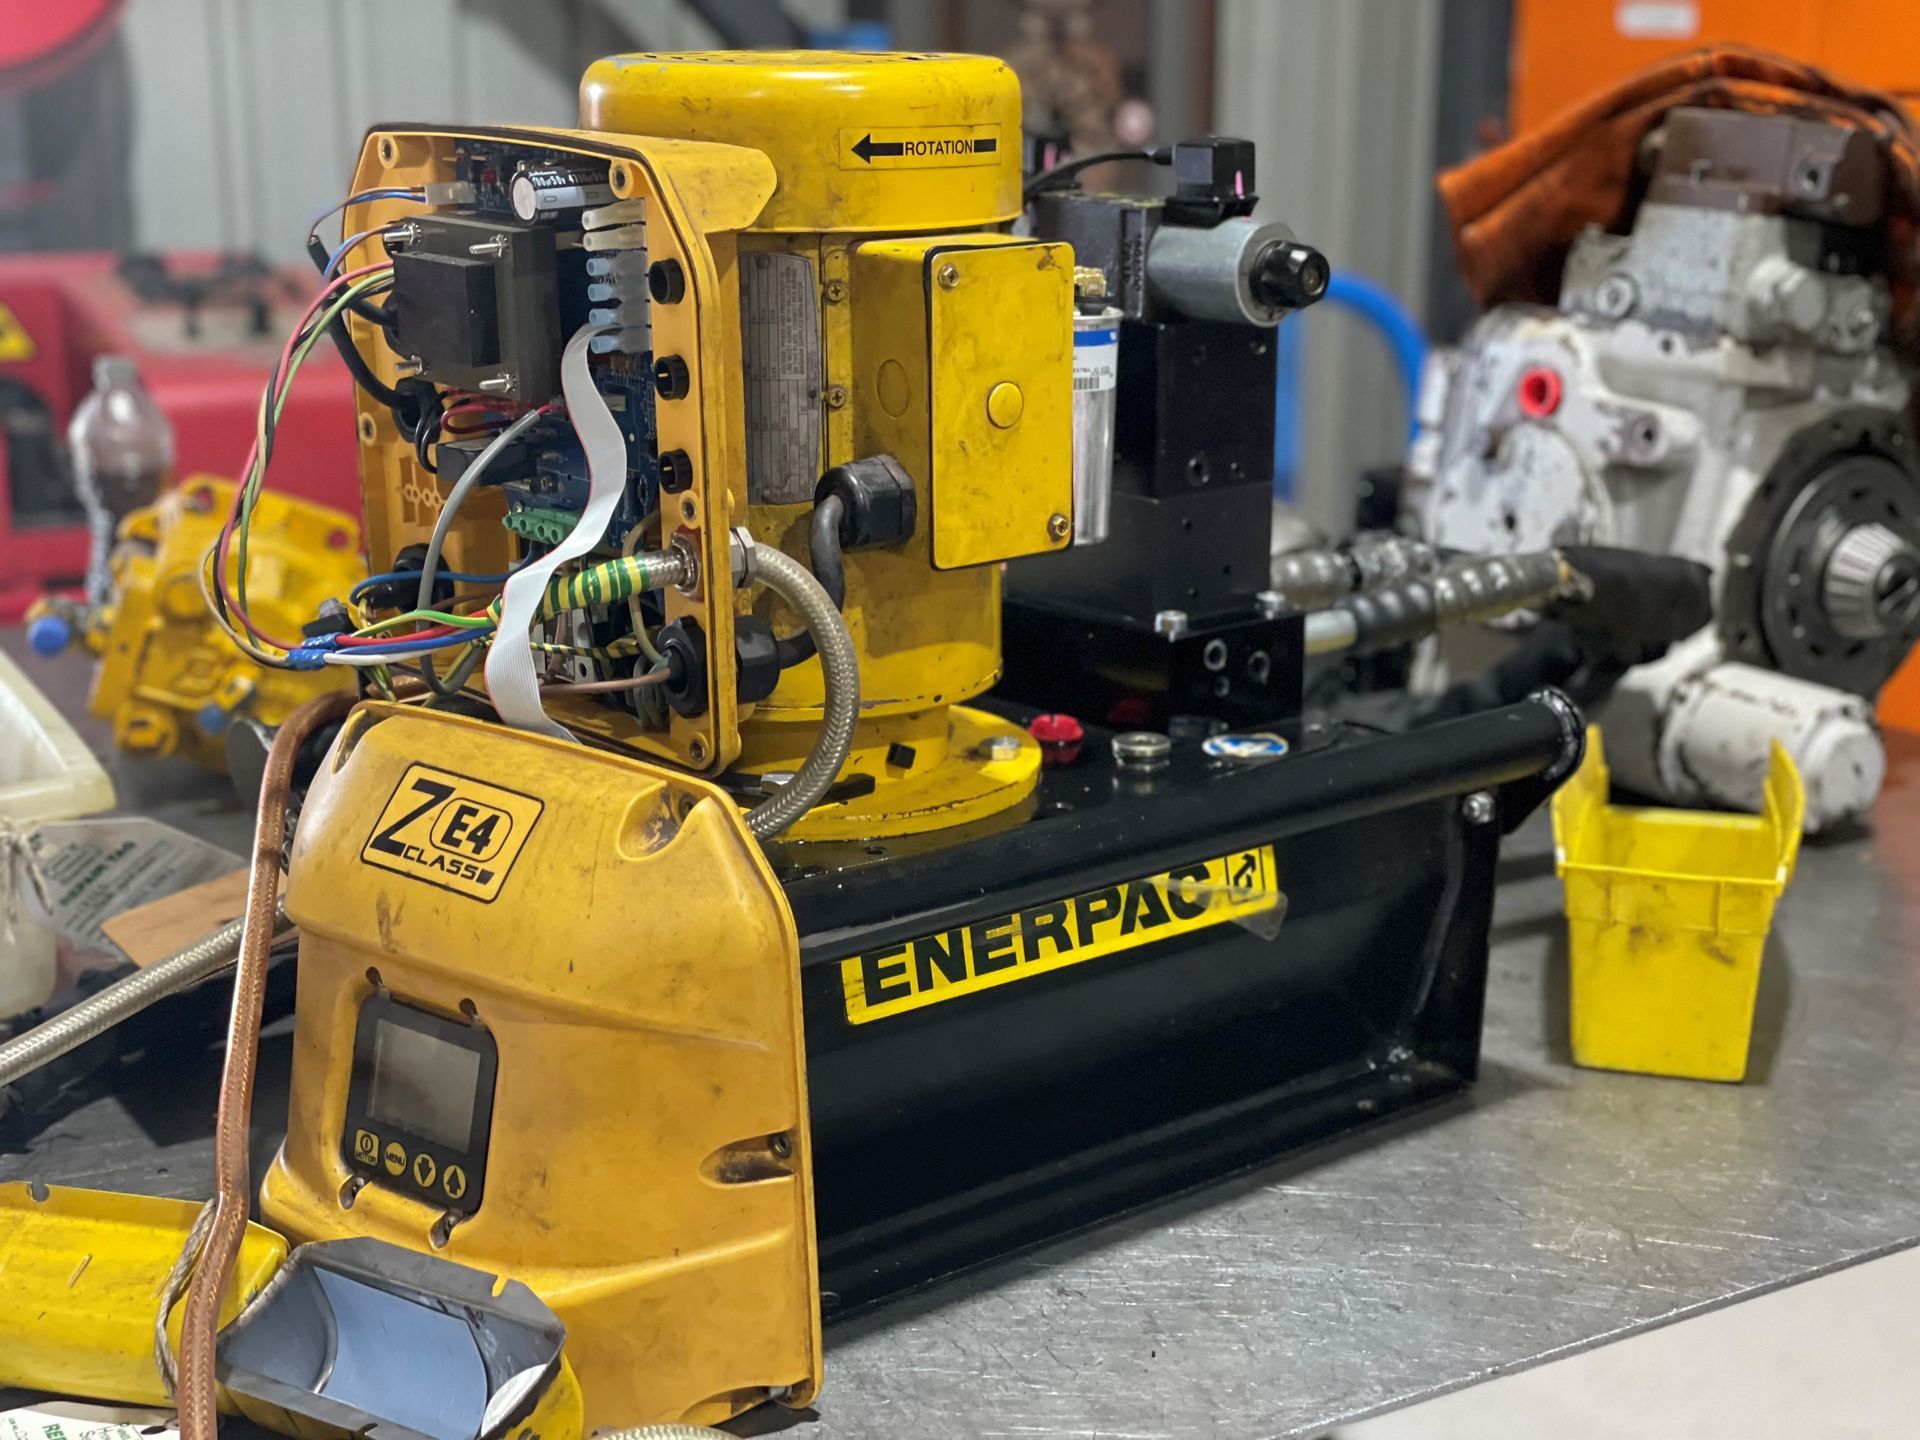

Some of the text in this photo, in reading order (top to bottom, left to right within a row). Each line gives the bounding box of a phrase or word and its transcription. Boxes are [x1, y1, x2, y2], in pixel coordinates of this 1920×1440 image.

[905, 139, 973, 156] ROTATION
[440, 804, 501, 855] E4
[403, 845, 479, 881] CLASS
[860, 864, 1213, 1007] ENERPAC
[355, 1151, 376, 1163] MOTOR
[385, 1151, 405, 1166] MENU
